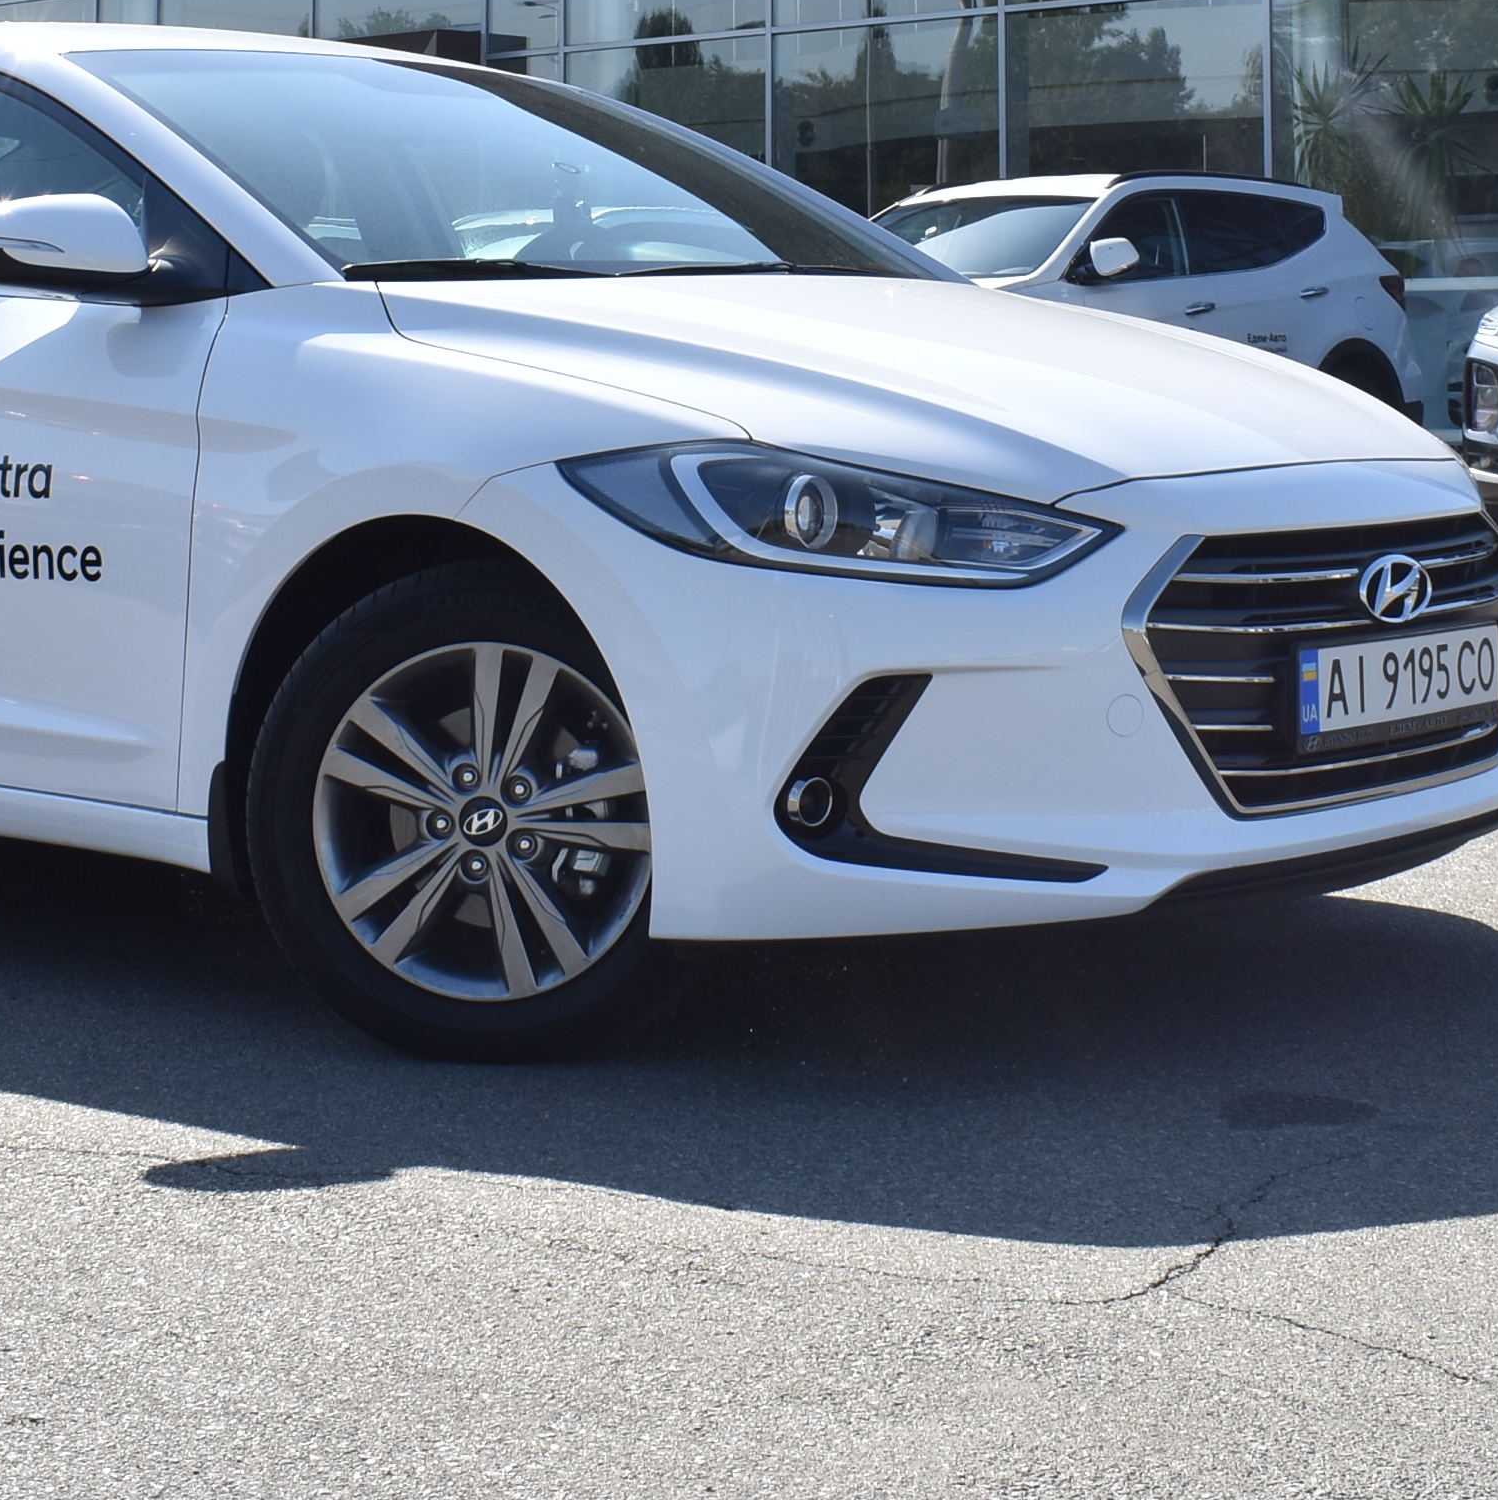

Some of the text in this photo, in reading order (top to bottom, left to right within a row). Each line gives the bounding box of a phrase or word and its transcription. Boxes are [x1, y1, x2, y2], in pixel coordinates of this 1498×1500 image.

[1326, 637, 1495, 719] AI 9195 CO
[1302, 703, 1319, 723] UA
